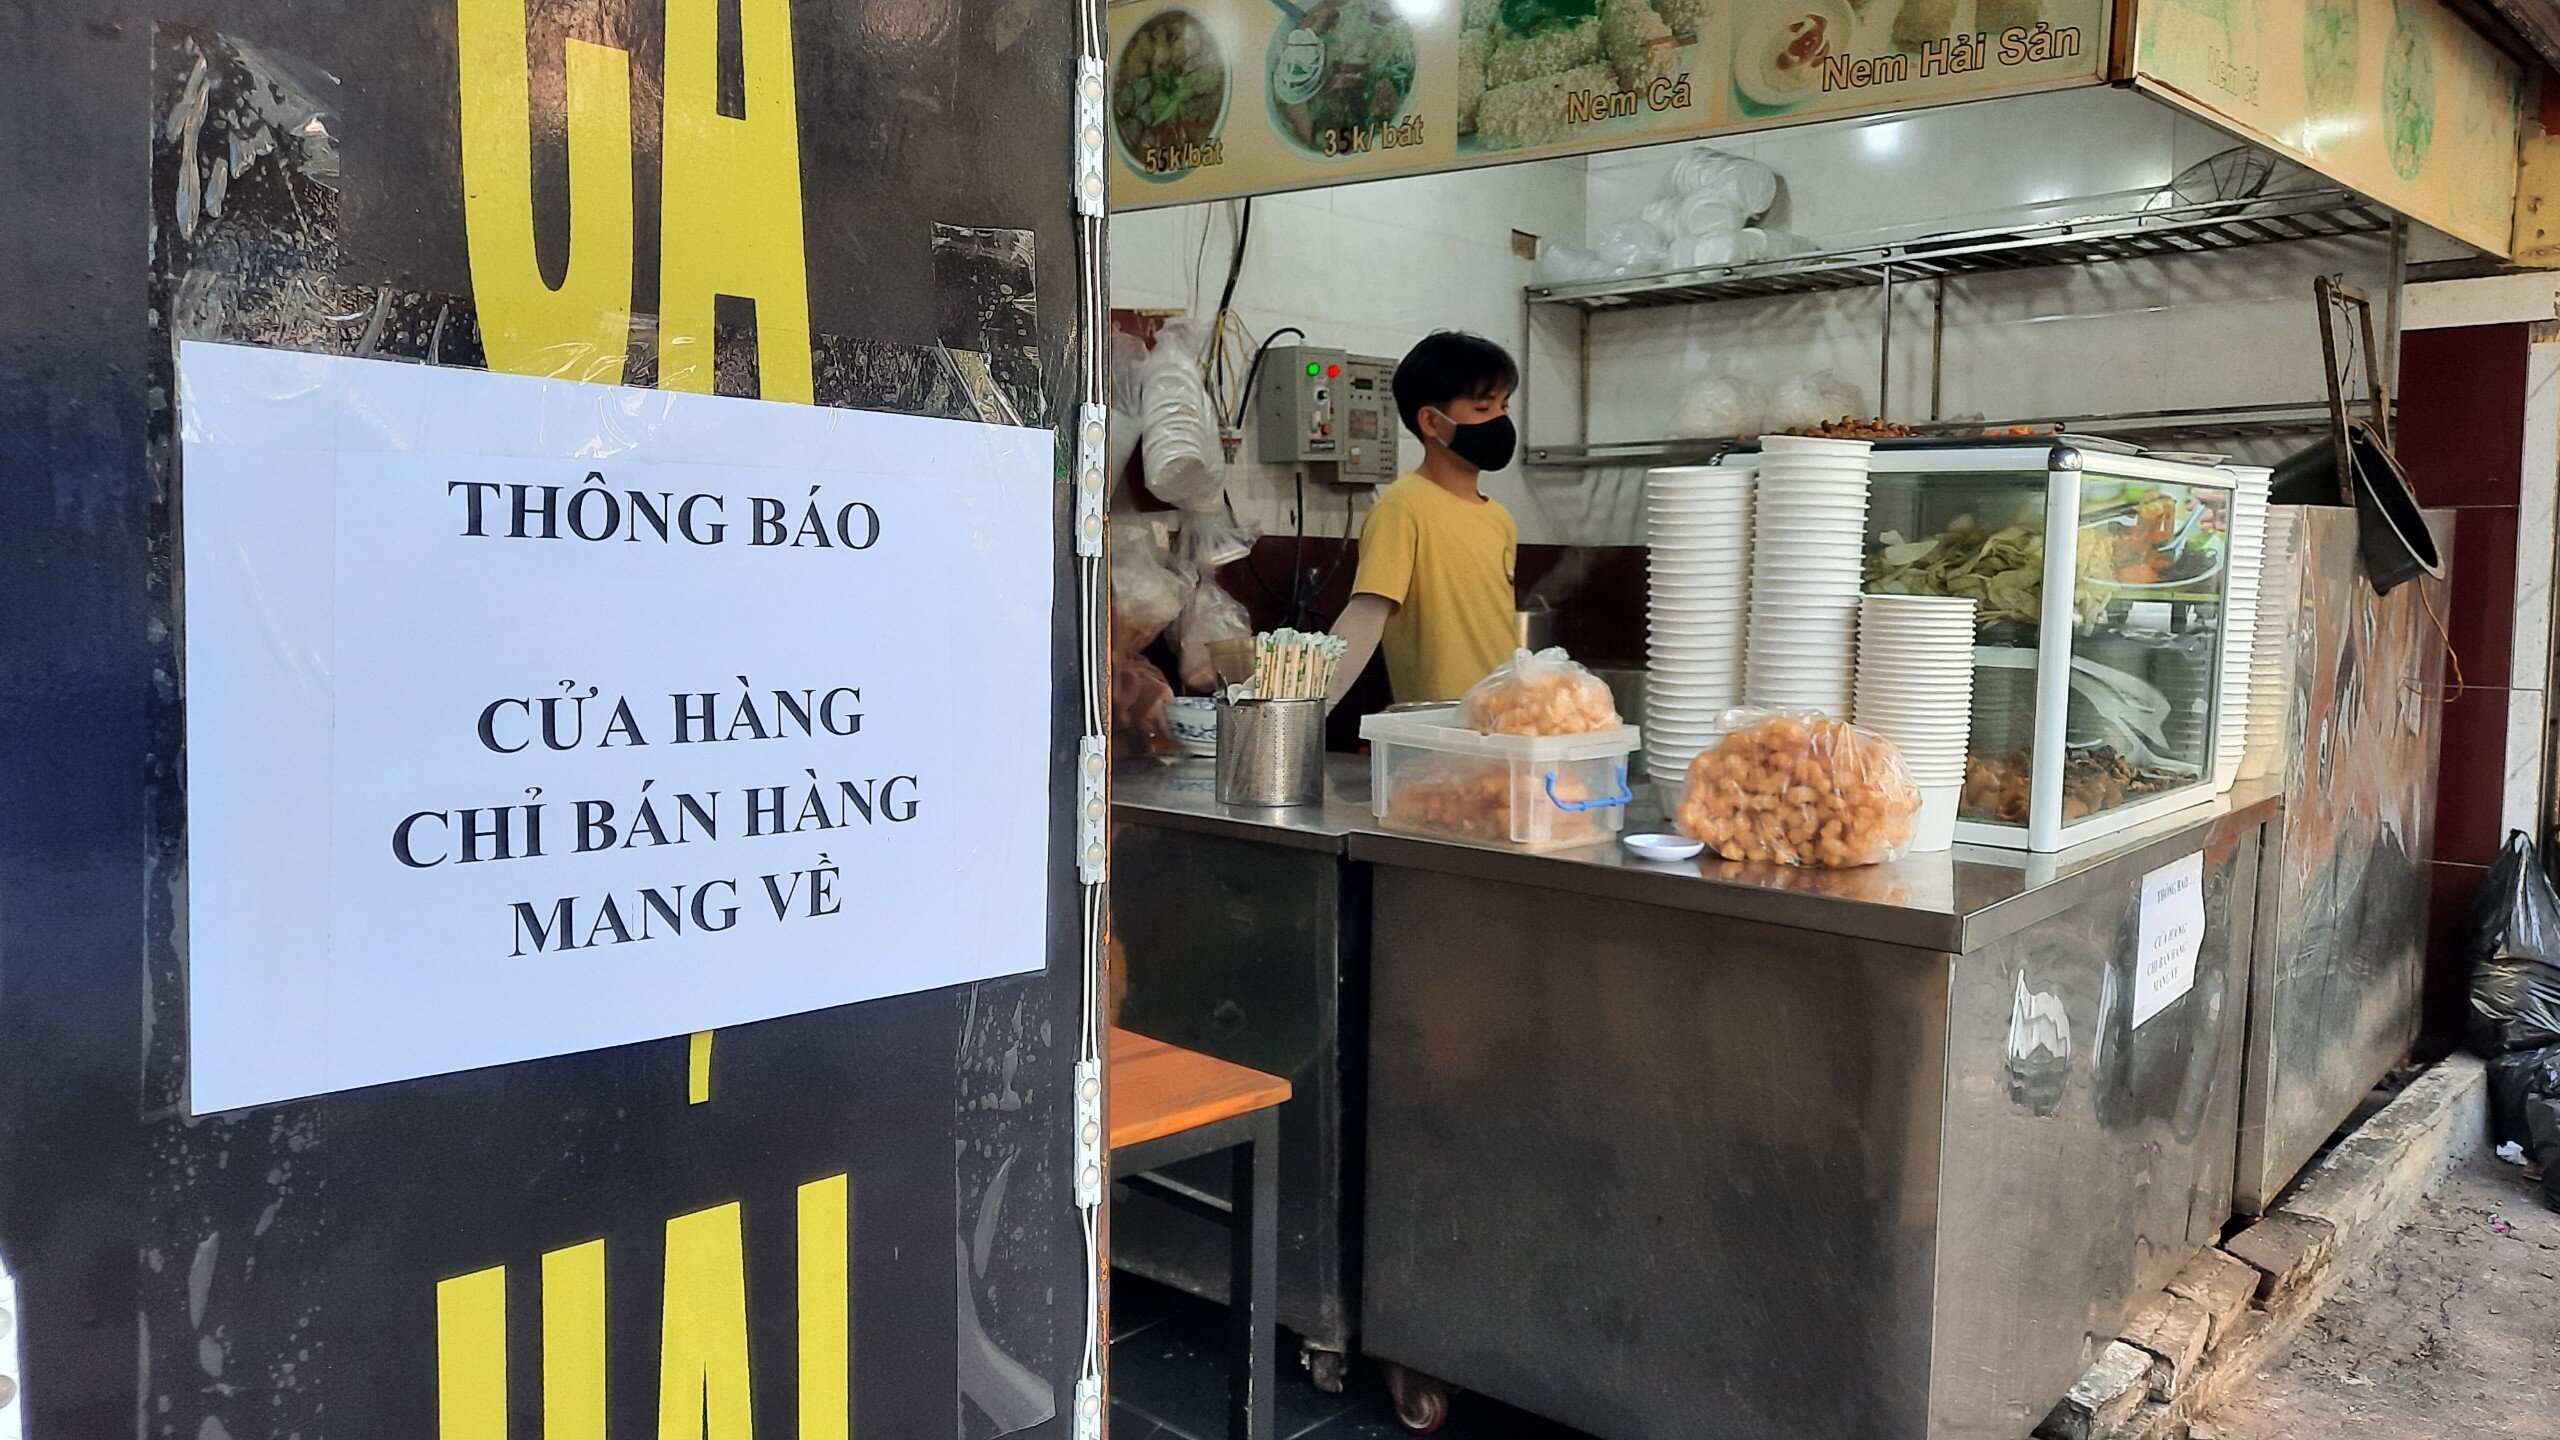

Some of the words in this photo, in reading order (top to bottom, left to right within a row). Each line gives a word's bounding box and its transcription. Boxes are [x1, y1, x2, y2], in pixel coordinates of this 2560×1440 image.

[1822, 53, 1907, 92] Nem
[1920, 32, 1987, 78] Hải
[1998, 21, 2080, 66] Sản
[1382, 114, 1424, 149] bát
[1568, 89, 1638, 124] Nem
[1647, 72, 1692, 112] Cá
[449, 471, 729, 546] THÔNG
[746, 484, 880, 550] BÁO
[477, 679, 650, 754] CỬA
[668, 675, 865, 745] HÀNG
[392, 786, 548, 868] CHỈ
[569, 779, 721, 854] BÁN
[741, 768, 921, 838] HÀNG
[507, 878, 742, 958] MANG
[758, 852, 843, 922] VỀ
